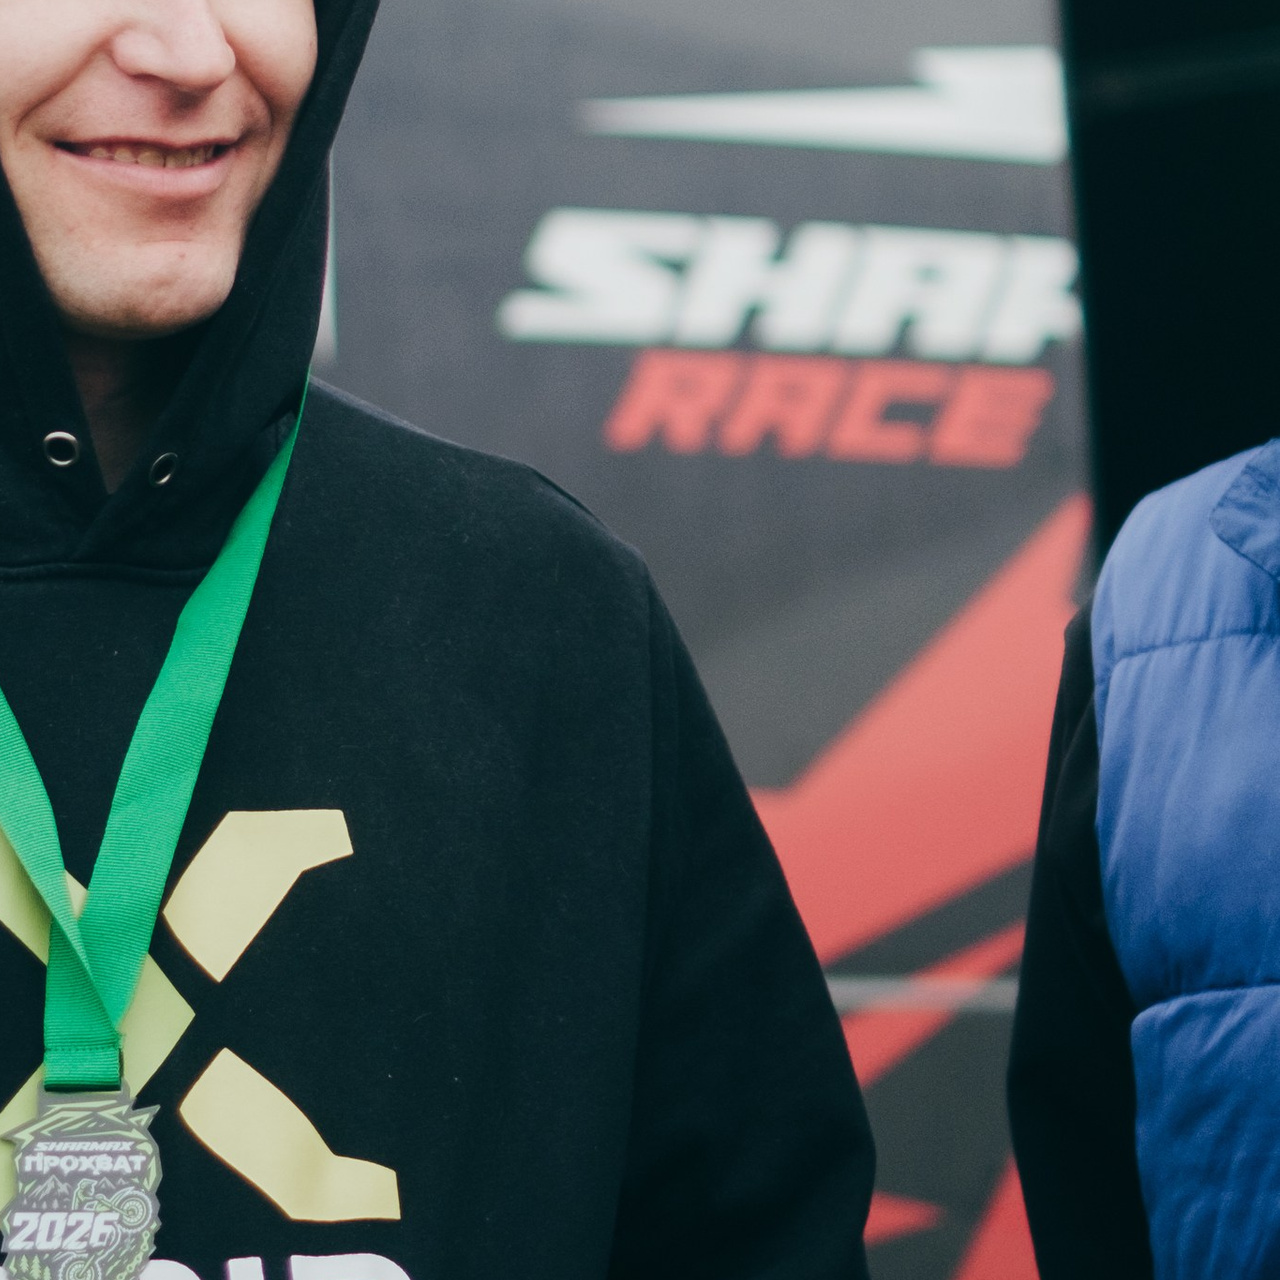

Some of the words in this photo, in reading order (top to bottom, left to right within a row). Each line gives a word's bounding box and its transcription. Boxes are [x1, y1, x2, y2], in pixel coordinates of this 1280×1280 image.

[603, 348, 1054, 469] RACE
[34, 1141, 135, 1153] SHARMAX
[24, 1153, 147, 1175] ПРОХВАТ
